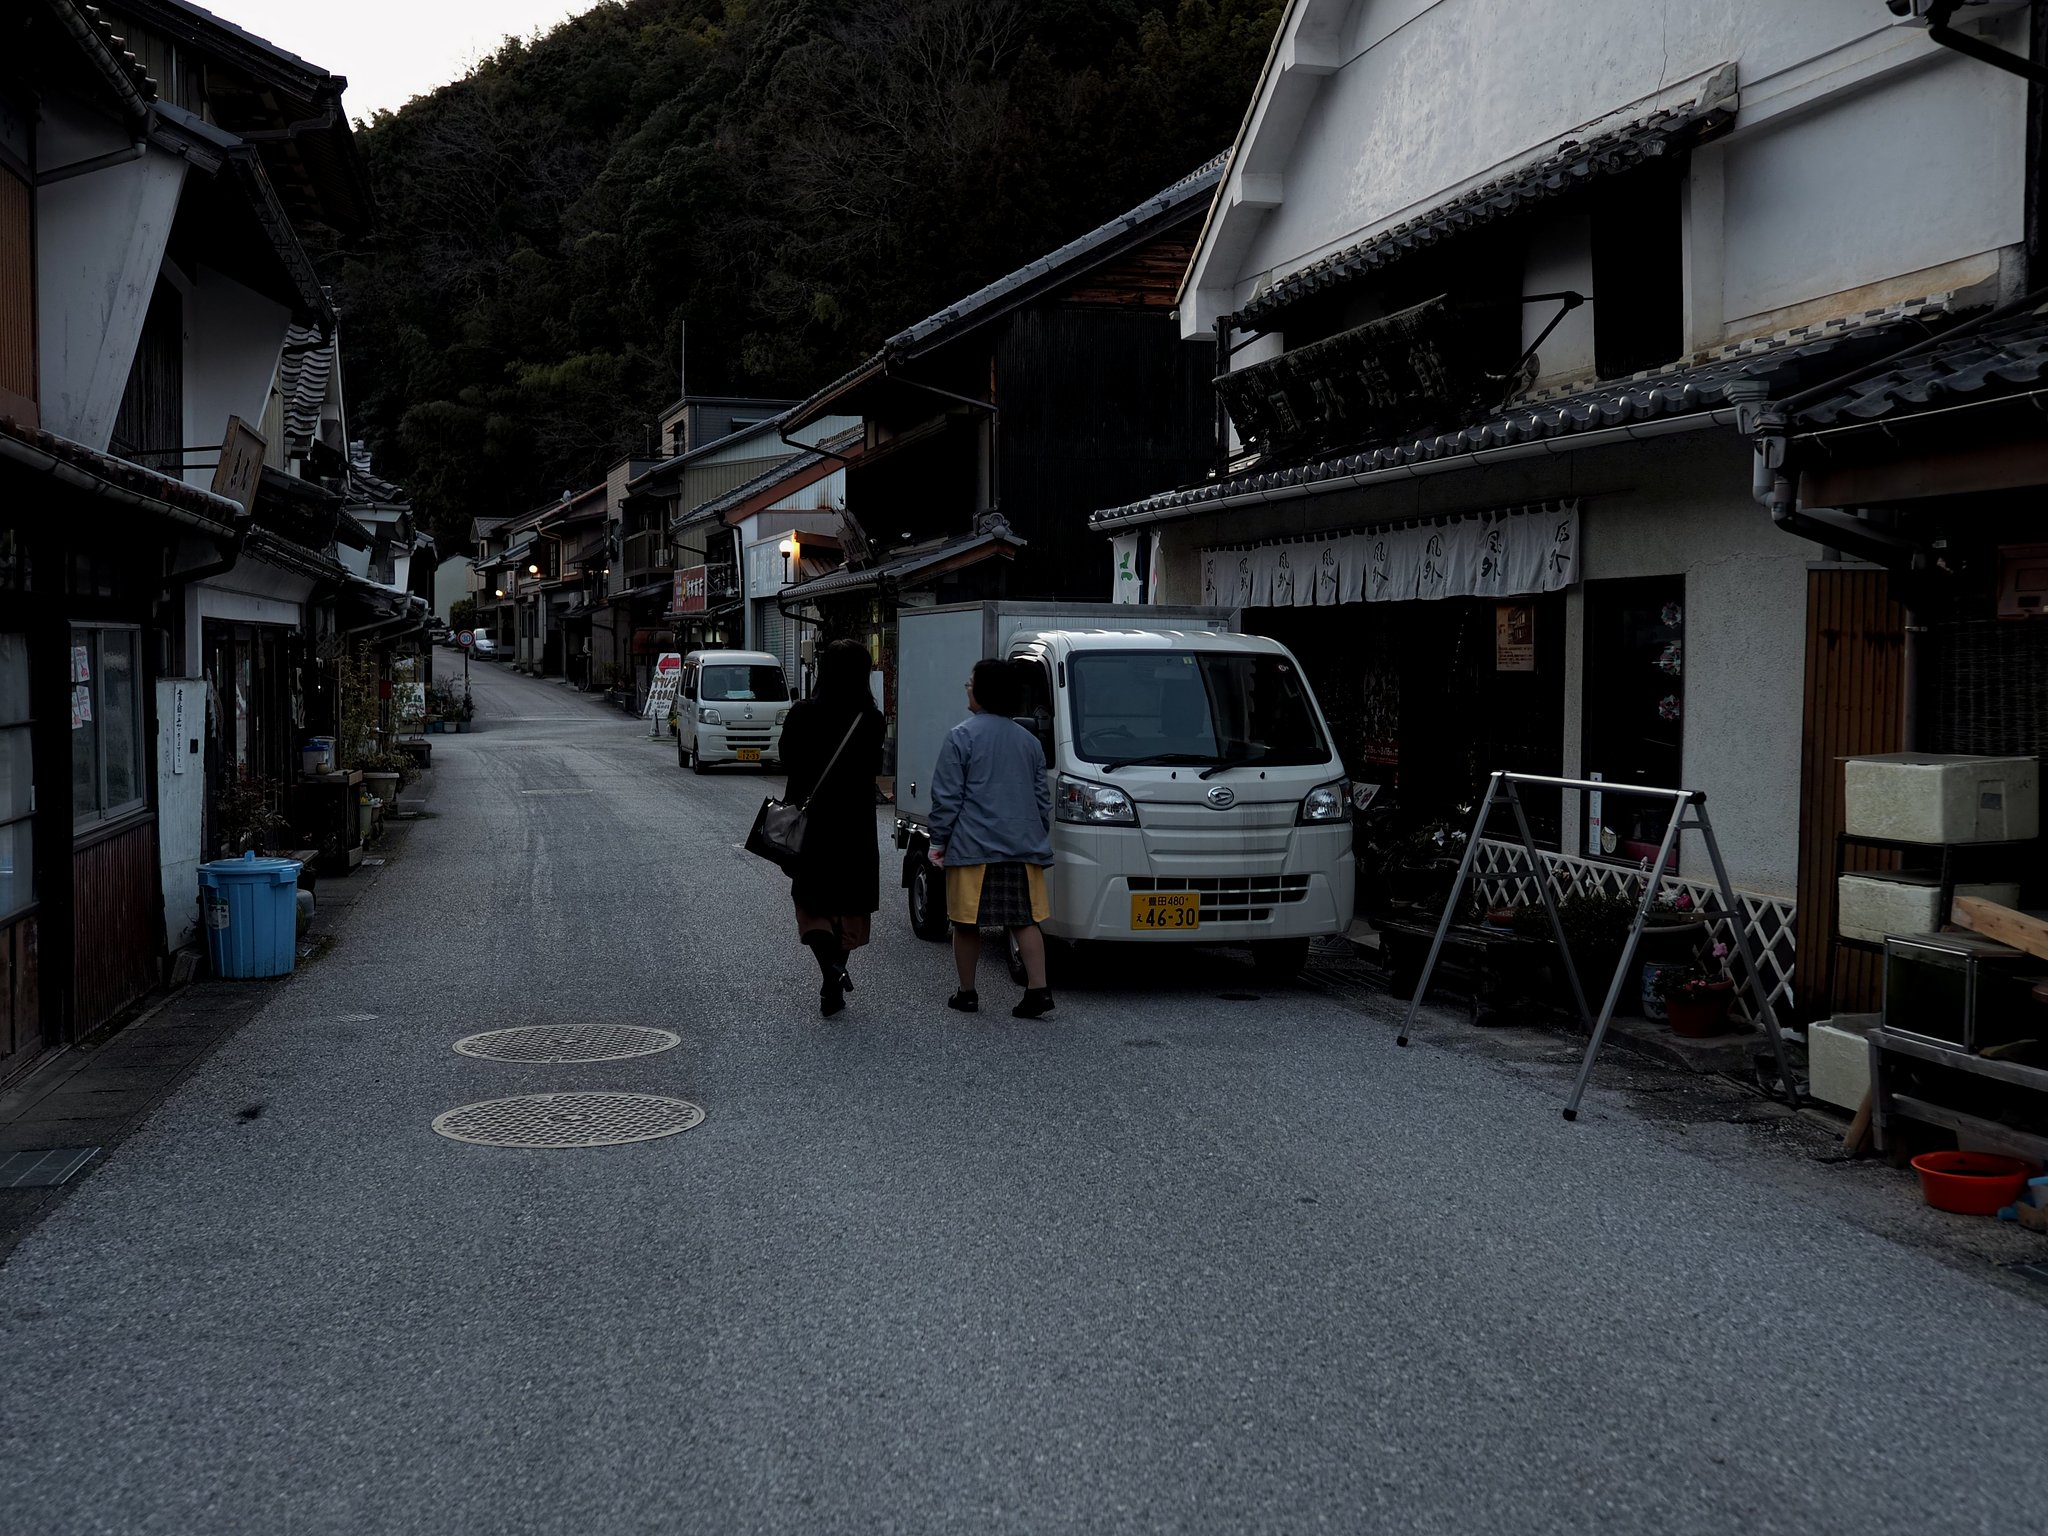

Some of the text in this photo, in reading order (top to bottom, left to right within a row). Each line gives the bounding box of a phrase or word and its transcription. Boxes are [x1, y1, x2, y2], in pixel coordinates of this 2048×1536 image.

[1321, 547, 1336, 589] 風外
[1373, 541, 1389, 585] 風外
[1423, 534, 1444, 583] 風外
[1481, 530, 1502, 582] 風外
[1136, 908, 1195, 927] え 46-30
